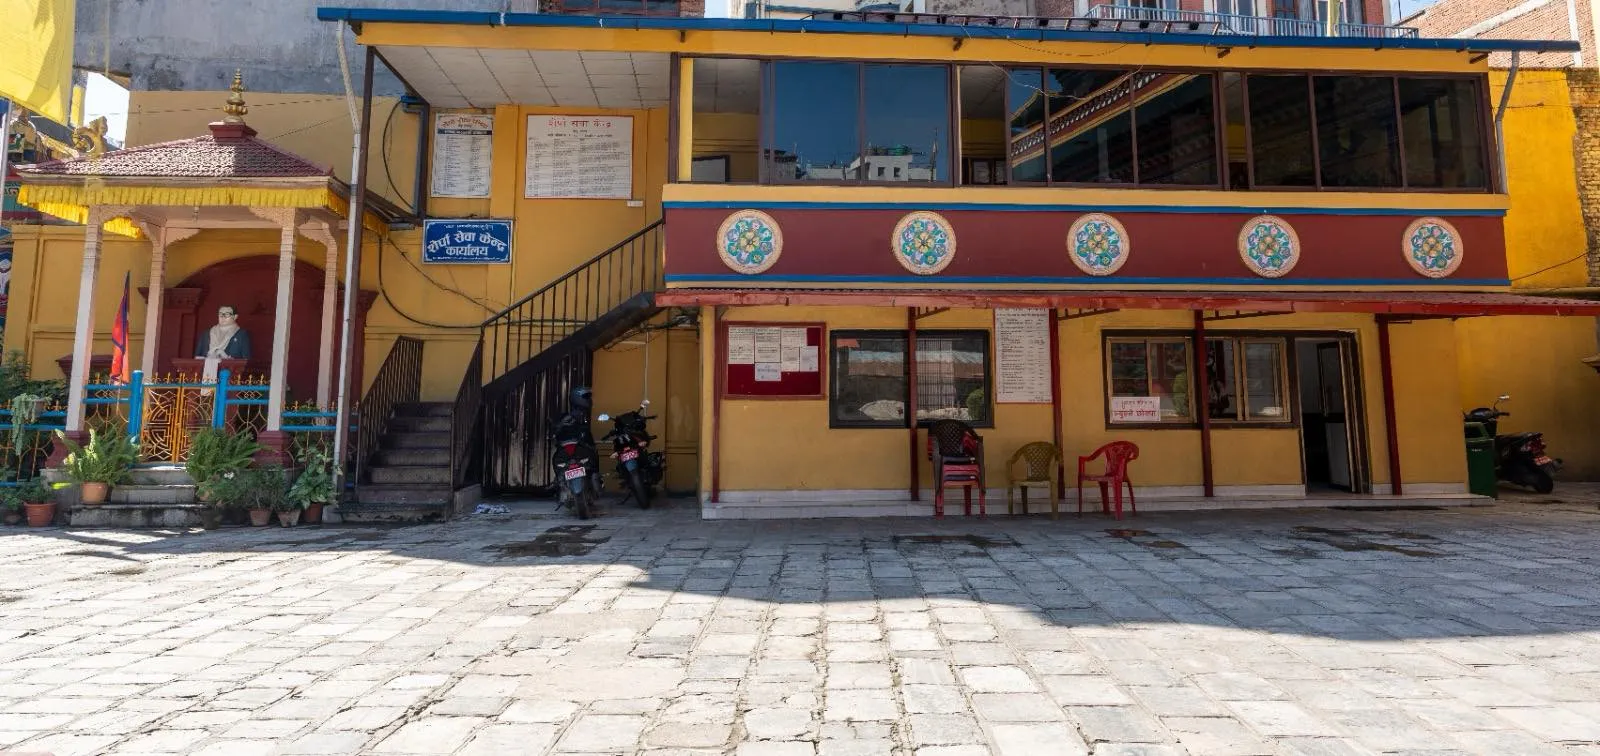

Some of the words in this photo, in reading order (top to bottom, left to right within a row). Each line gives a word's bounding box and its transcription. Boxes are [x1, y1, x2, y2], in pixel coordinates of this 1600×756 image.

[427, 233, 451, 253] शेर्पा
[454, 230, 477, 243] सेवा
[479, 232, 508, 252] केन्द्र
[445, 244, 489, 256] कार्यालय
